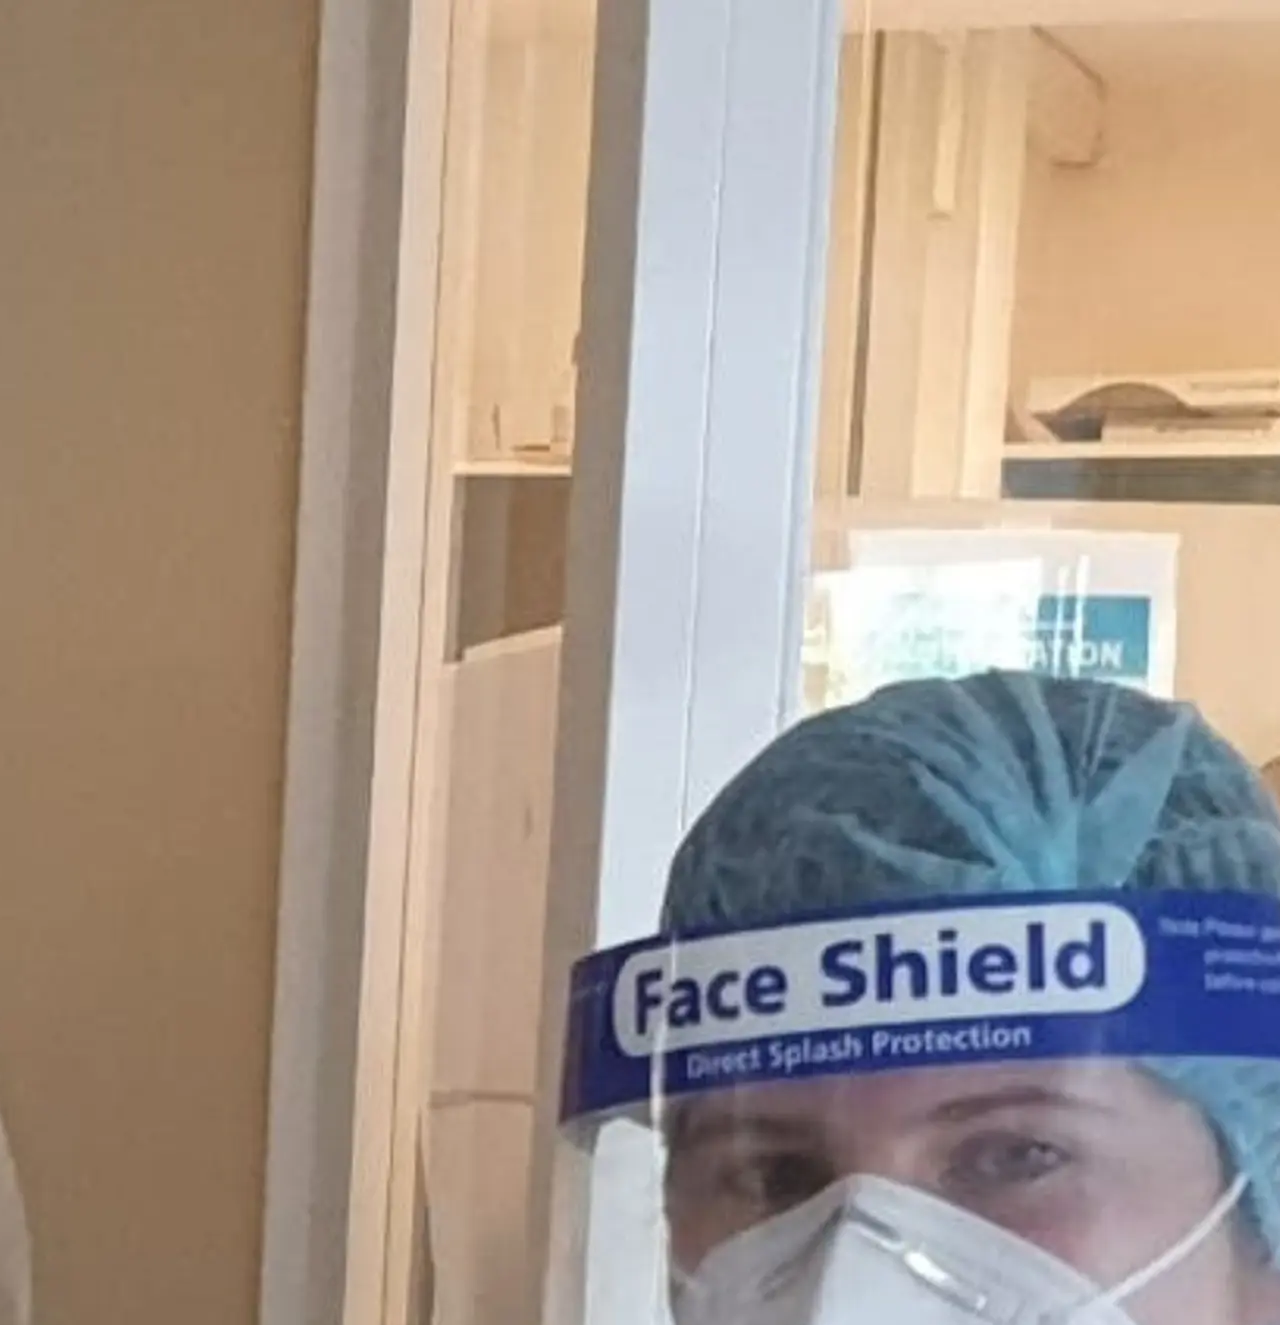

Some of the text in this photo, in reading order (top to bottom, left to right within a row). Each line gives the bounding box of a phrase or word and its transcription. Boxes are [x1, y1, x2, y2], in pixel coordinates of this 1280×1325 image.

[636, 920, 1107, 1036] Face Shield
[686, 1023, 1031, 1080] Direct Splash Protection
